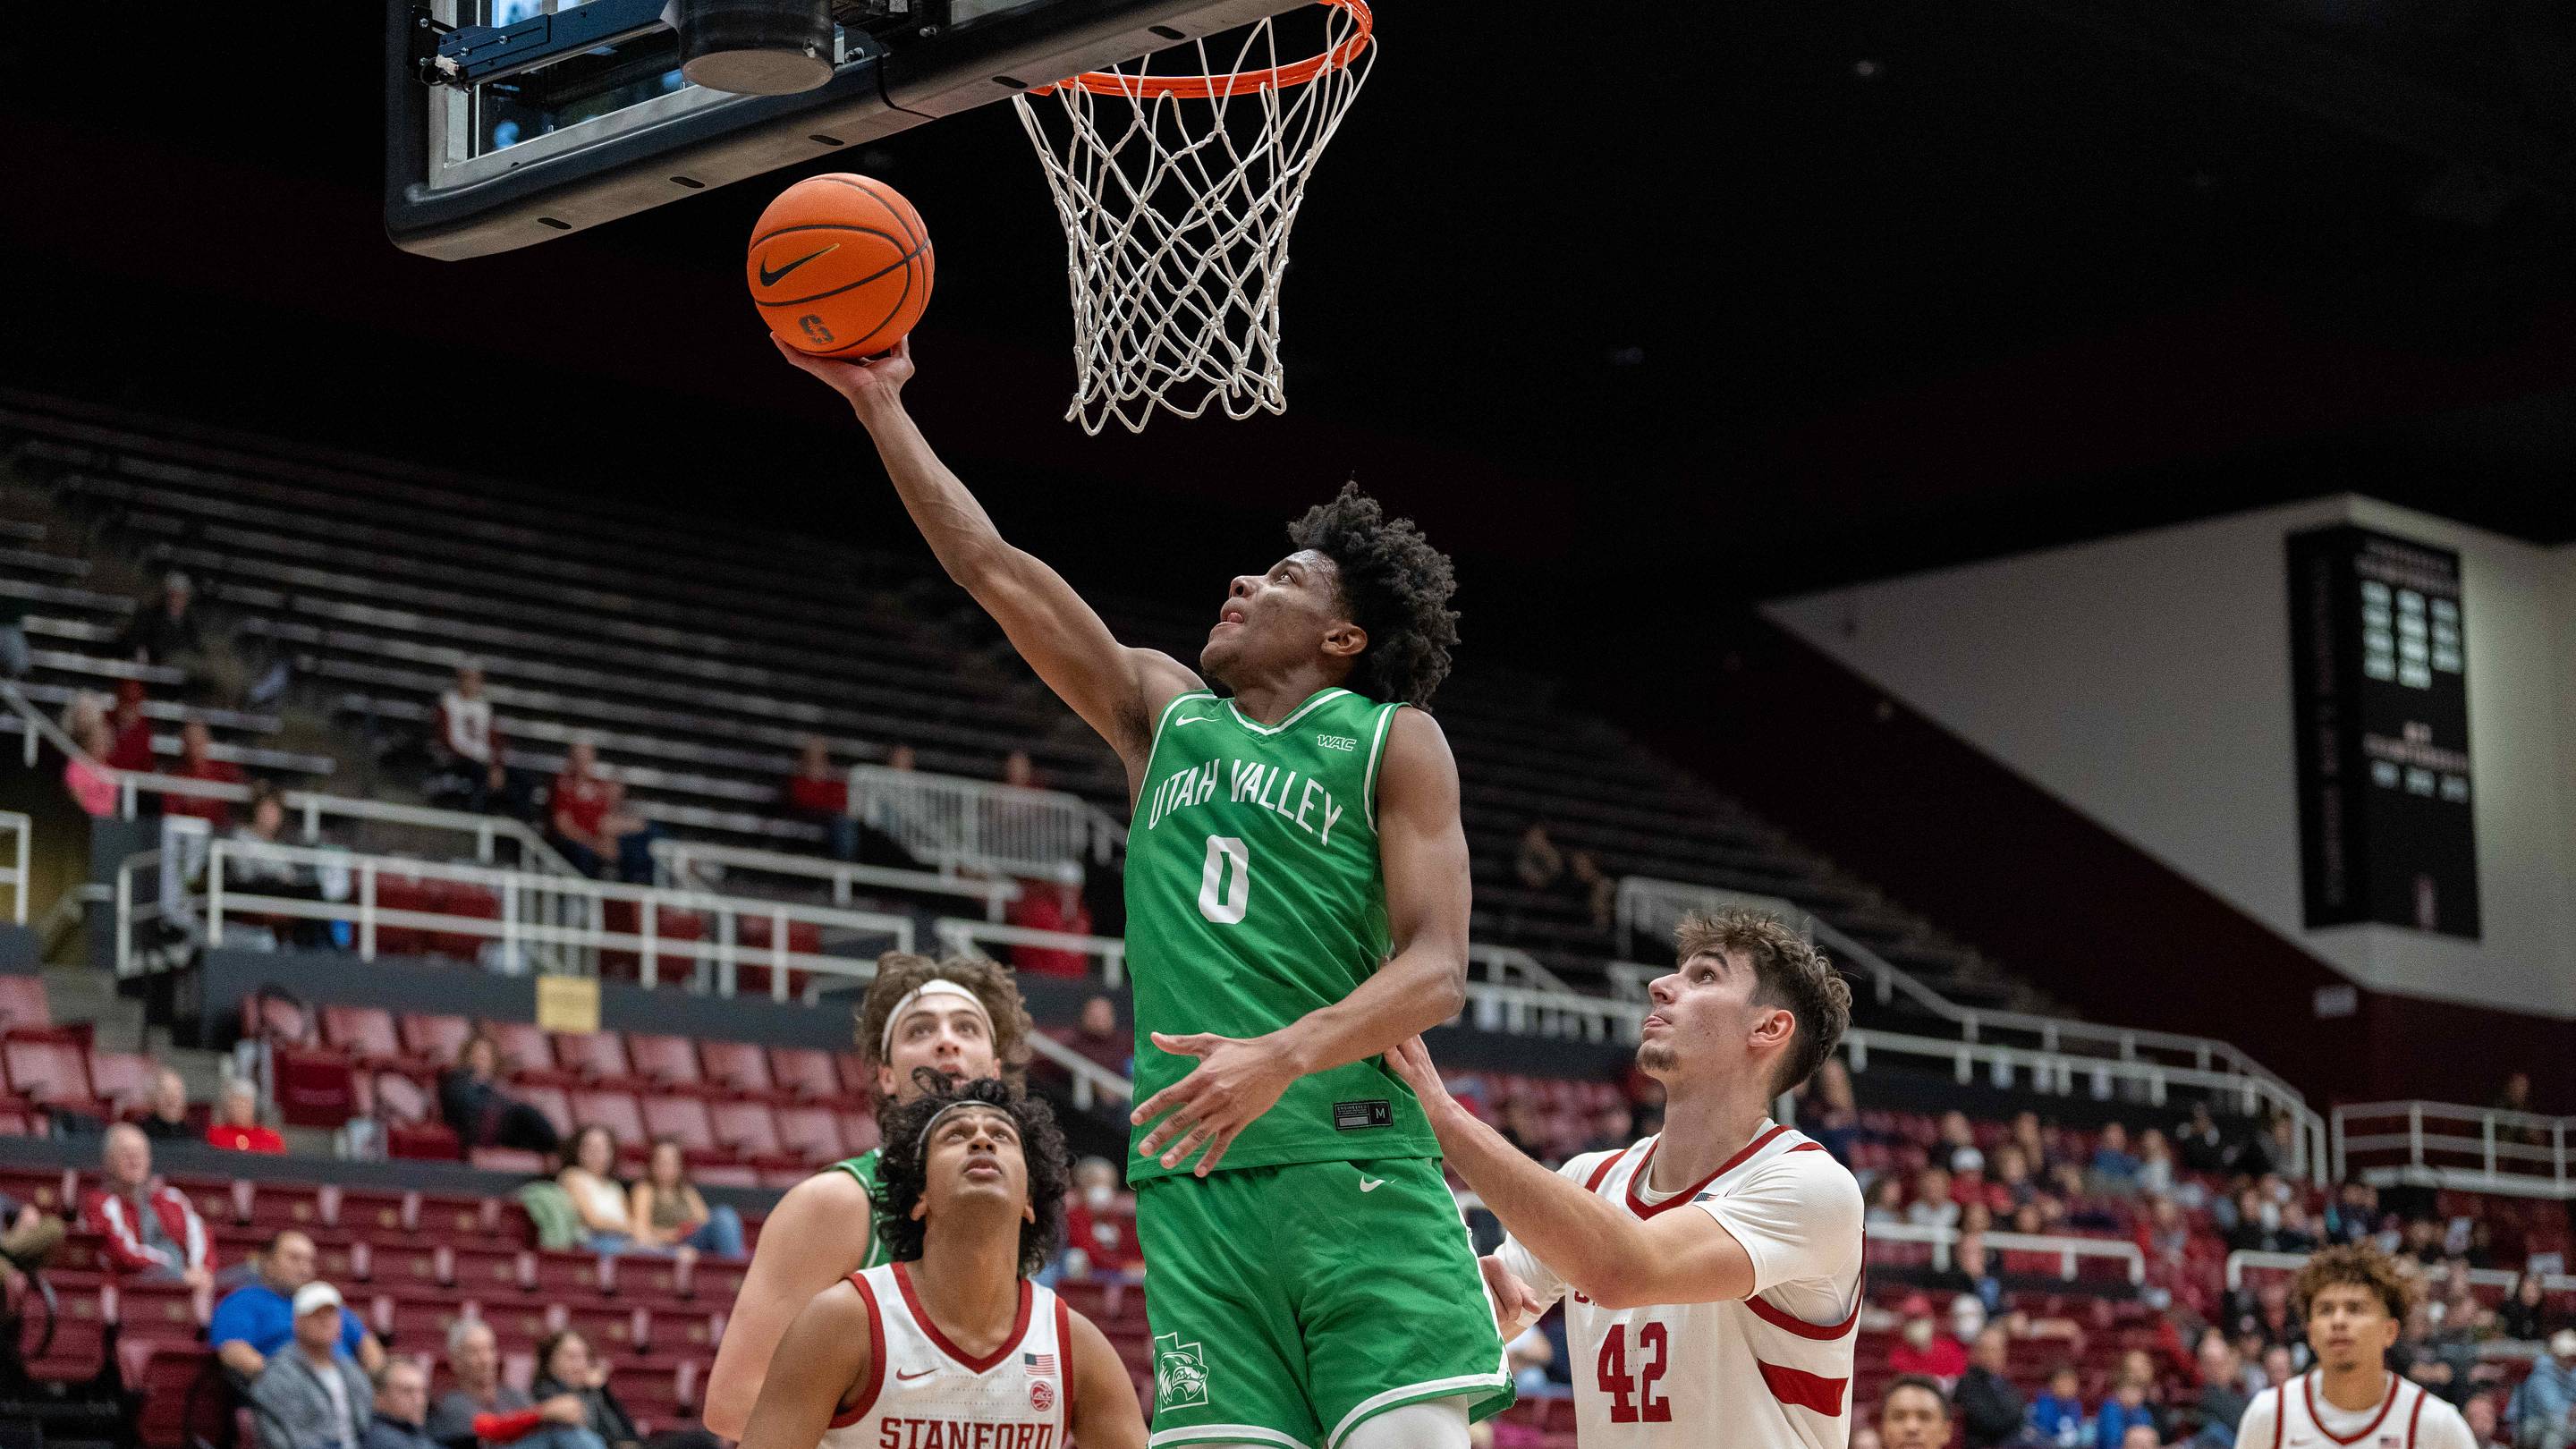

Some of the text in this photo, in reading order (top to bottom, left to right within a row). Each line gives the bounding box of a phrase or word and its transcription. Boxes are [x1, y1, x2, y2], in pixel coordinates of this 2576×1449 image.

[1317, 733, 1357, 751] WAC
[1148, 758, 1343, 846] UTAH VALLEY
[1199, 835, 1250, 924] 0
[1375, 1107, 1385, 1119] M
[1597, 1322, 1672, 1423] 42
[880, 1417, 1054, 1449] STANFORD
